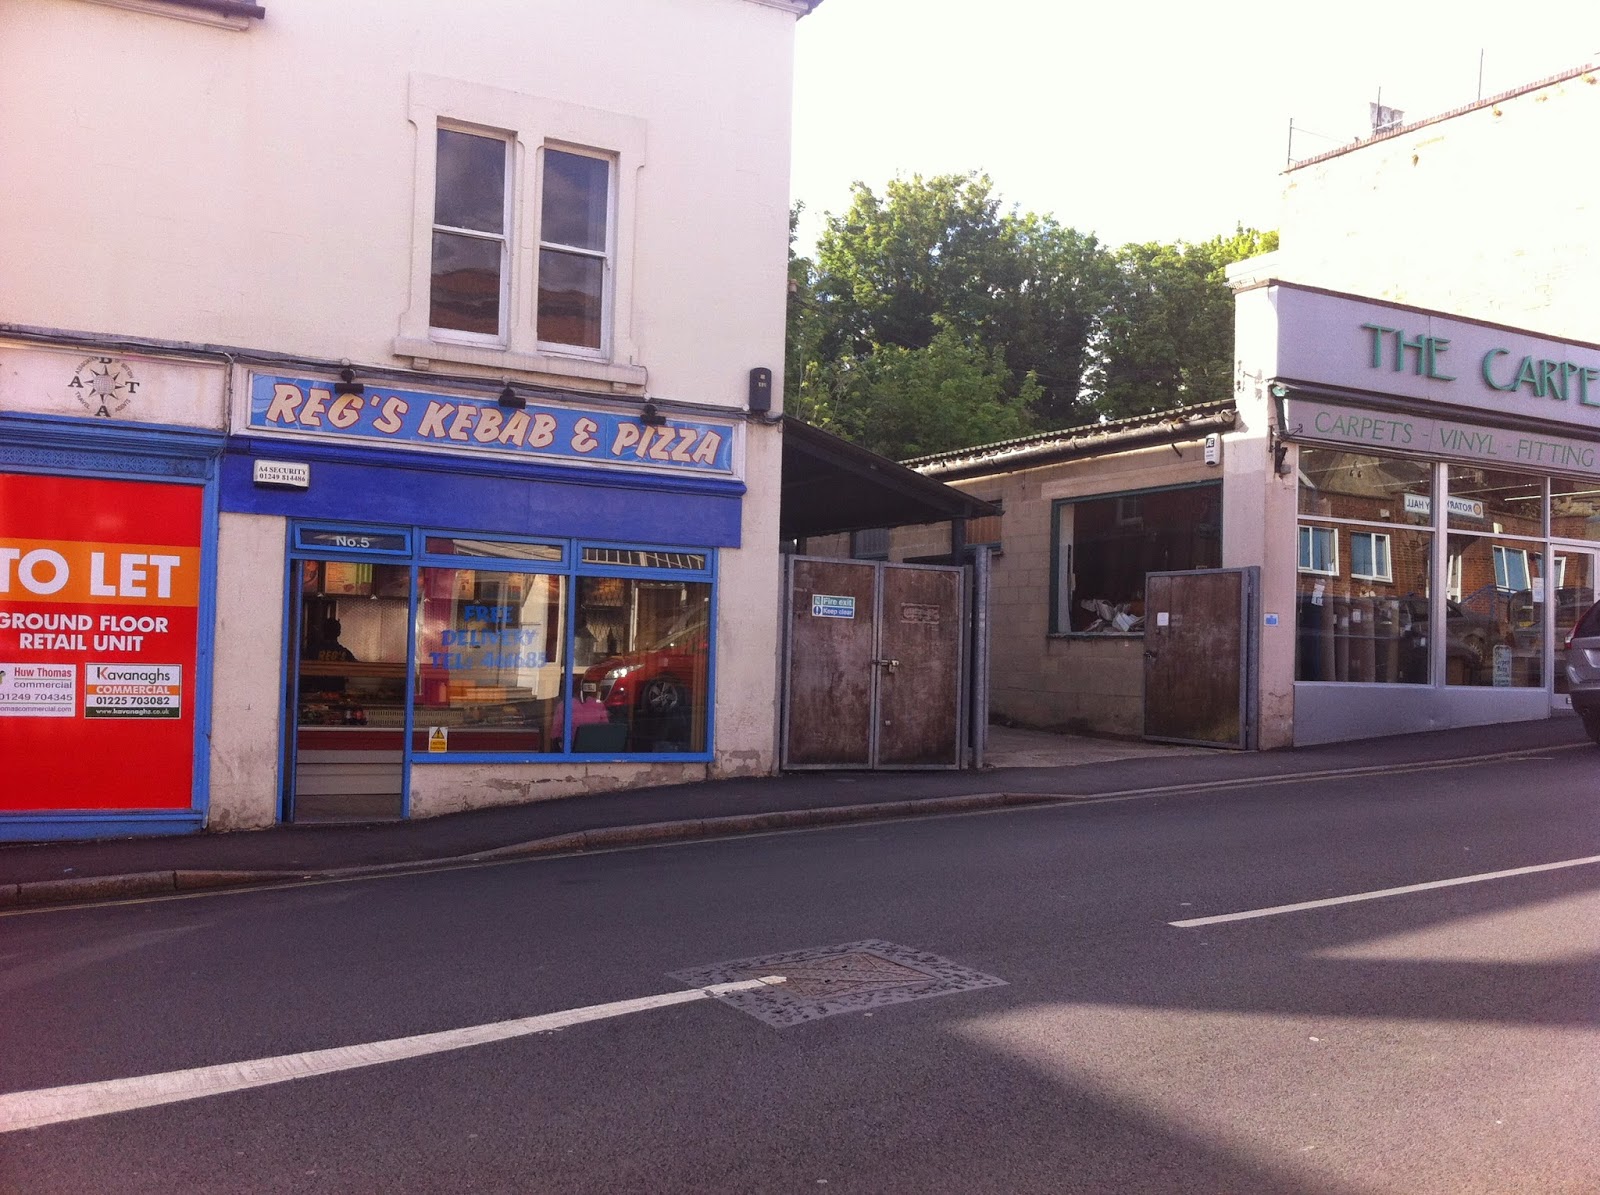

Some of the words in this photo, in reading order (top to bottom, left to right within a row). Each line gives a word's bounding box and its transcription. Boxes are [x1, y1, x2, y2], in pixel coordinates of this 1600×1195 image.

[1361, 323, 1457, 381] THE
[1482, 347, 1600, 407] CARPE
[266, 383, 408, 434] REG'S
[417, 400, 557, 448] KEBAB
[570, 416, 599, 453] &
[611, 421, 722, 465] PIZZA
[1314, 411, 1414, 444] CARPETS
[1439, 427, 1498, 455] VINYL
[1516, 438, 1595, 468] FITTING
[269, 466, 307, 475] SECURITY
[335, 535, 370, 548] No.5
[0, 548, 70, 595] TO
[90, 552, 181, 599] LET
[823, 597, 837, 606] Fire
[839, 598, 852, 607] exit
[464, 605, 514, 623] FREE
[823, 607, 837, 615] Keep
[838, 608, 853, 616] clear
[0, 613, 93, 631] GROUND
[99, 616, 169, 633] FLOOR
[19, 633, 87, 651] RETAIL
[93, 635, 144, 652] UNIT
[441, 629, 537, 646] DELIVERY
[14, 667, 34, 677] Huw
[37, 668, 72, 678] Thomas
[96, 667, 171, 685] Kavanaghs
[14, 681, 72, 689] commercial
[96, 685, 170, 694] COMMERCIAL
[0, 693, 31, 701] 01249
[34, 693, 73, 701] 704345
[96, 696, 128, 705] 01225
[130, 696, 170, 705] 703082
